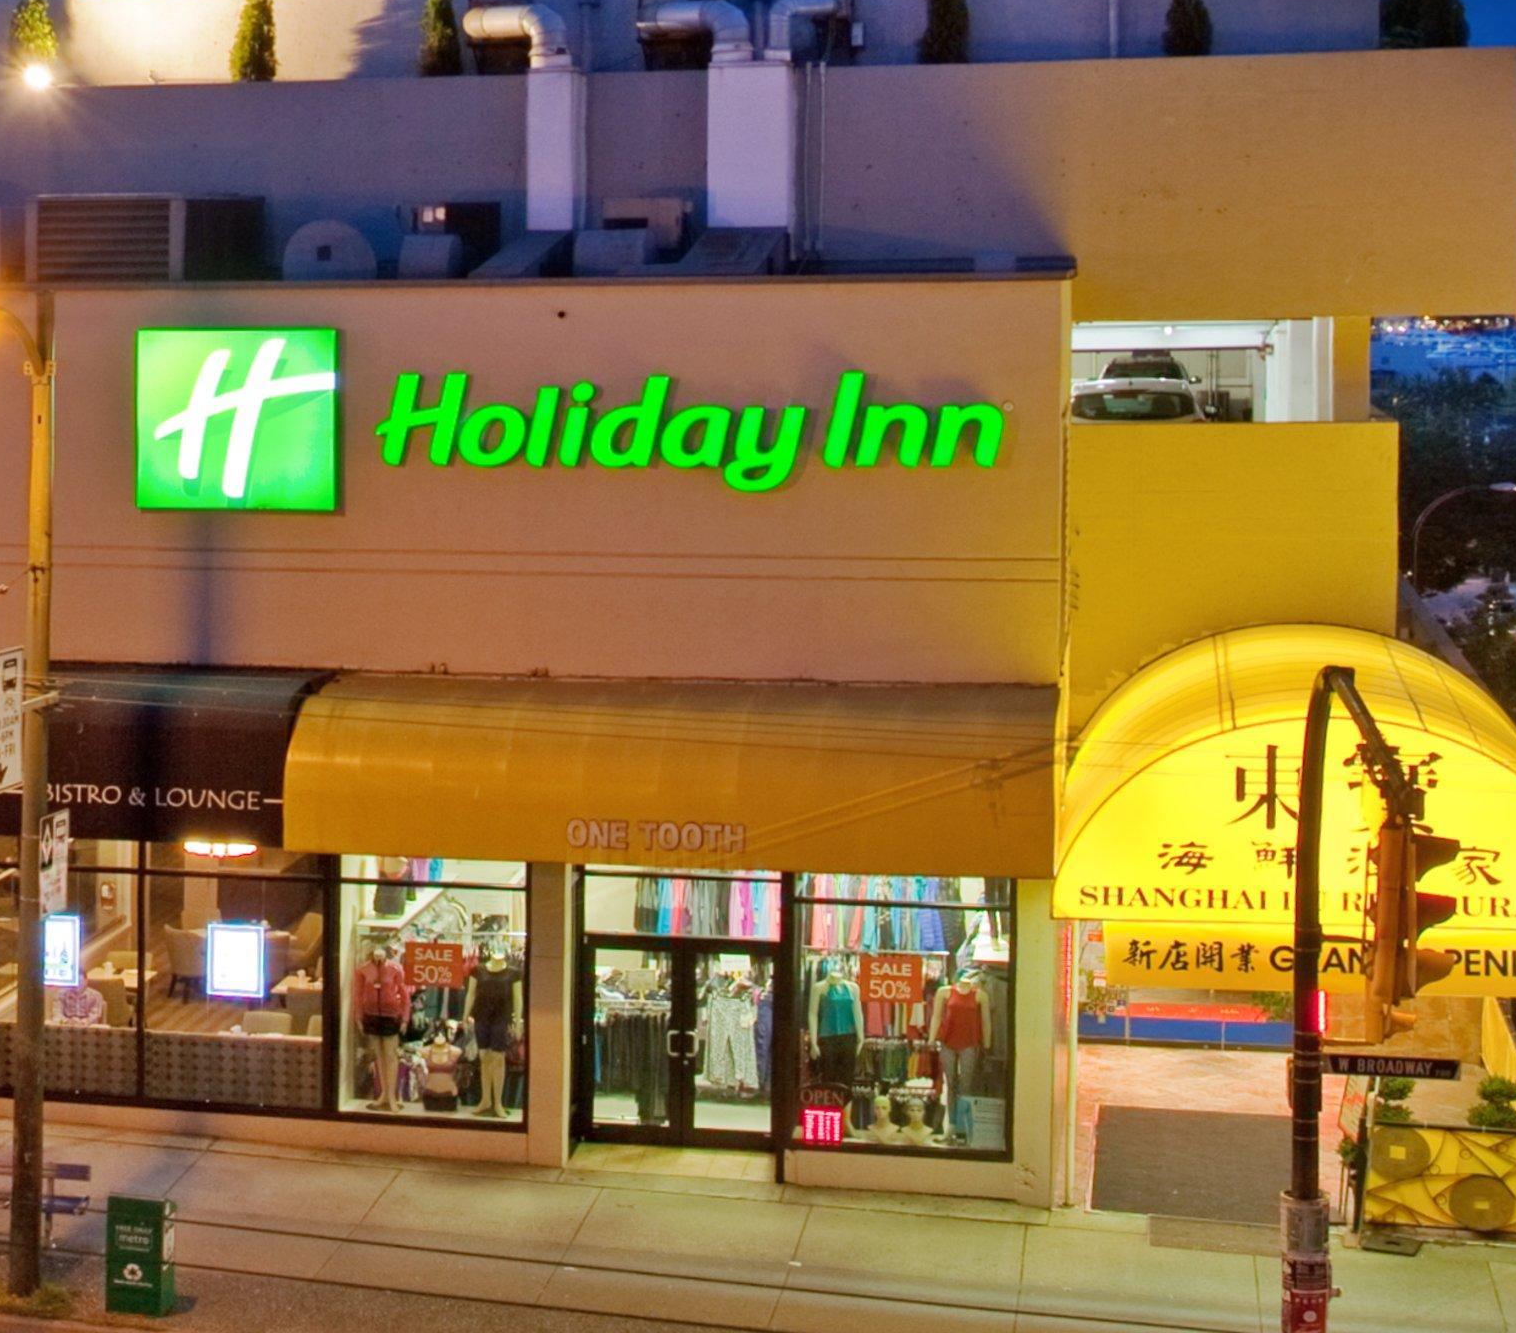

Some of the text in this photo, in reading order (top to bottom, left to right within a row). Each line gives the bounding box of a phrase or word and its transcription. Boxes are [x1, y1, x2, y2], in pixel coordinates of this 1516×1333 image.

[375, 371, 1004, 492] Holiday Inn
[128, 787, 146, 807] &
[155, 787, 261, 811] LOUNGE
[567, 818, 747, 853] ONE TOOTH
[1079, 885, 1266, 910] SHANGHAI
[414, 947, 453, 962] SALE
[1122, 939, 1260, 973] 新店開業
[413, 964, 452, 983] 50%
[870, 962, 912, 976] SALE
[869, 979, 911, 999] 50%
[1338, 1057, 1349, 1071] W
[1357, 1058, 1433, 1075] BROADWAY
[118, 1234, 150, 1245] metro
